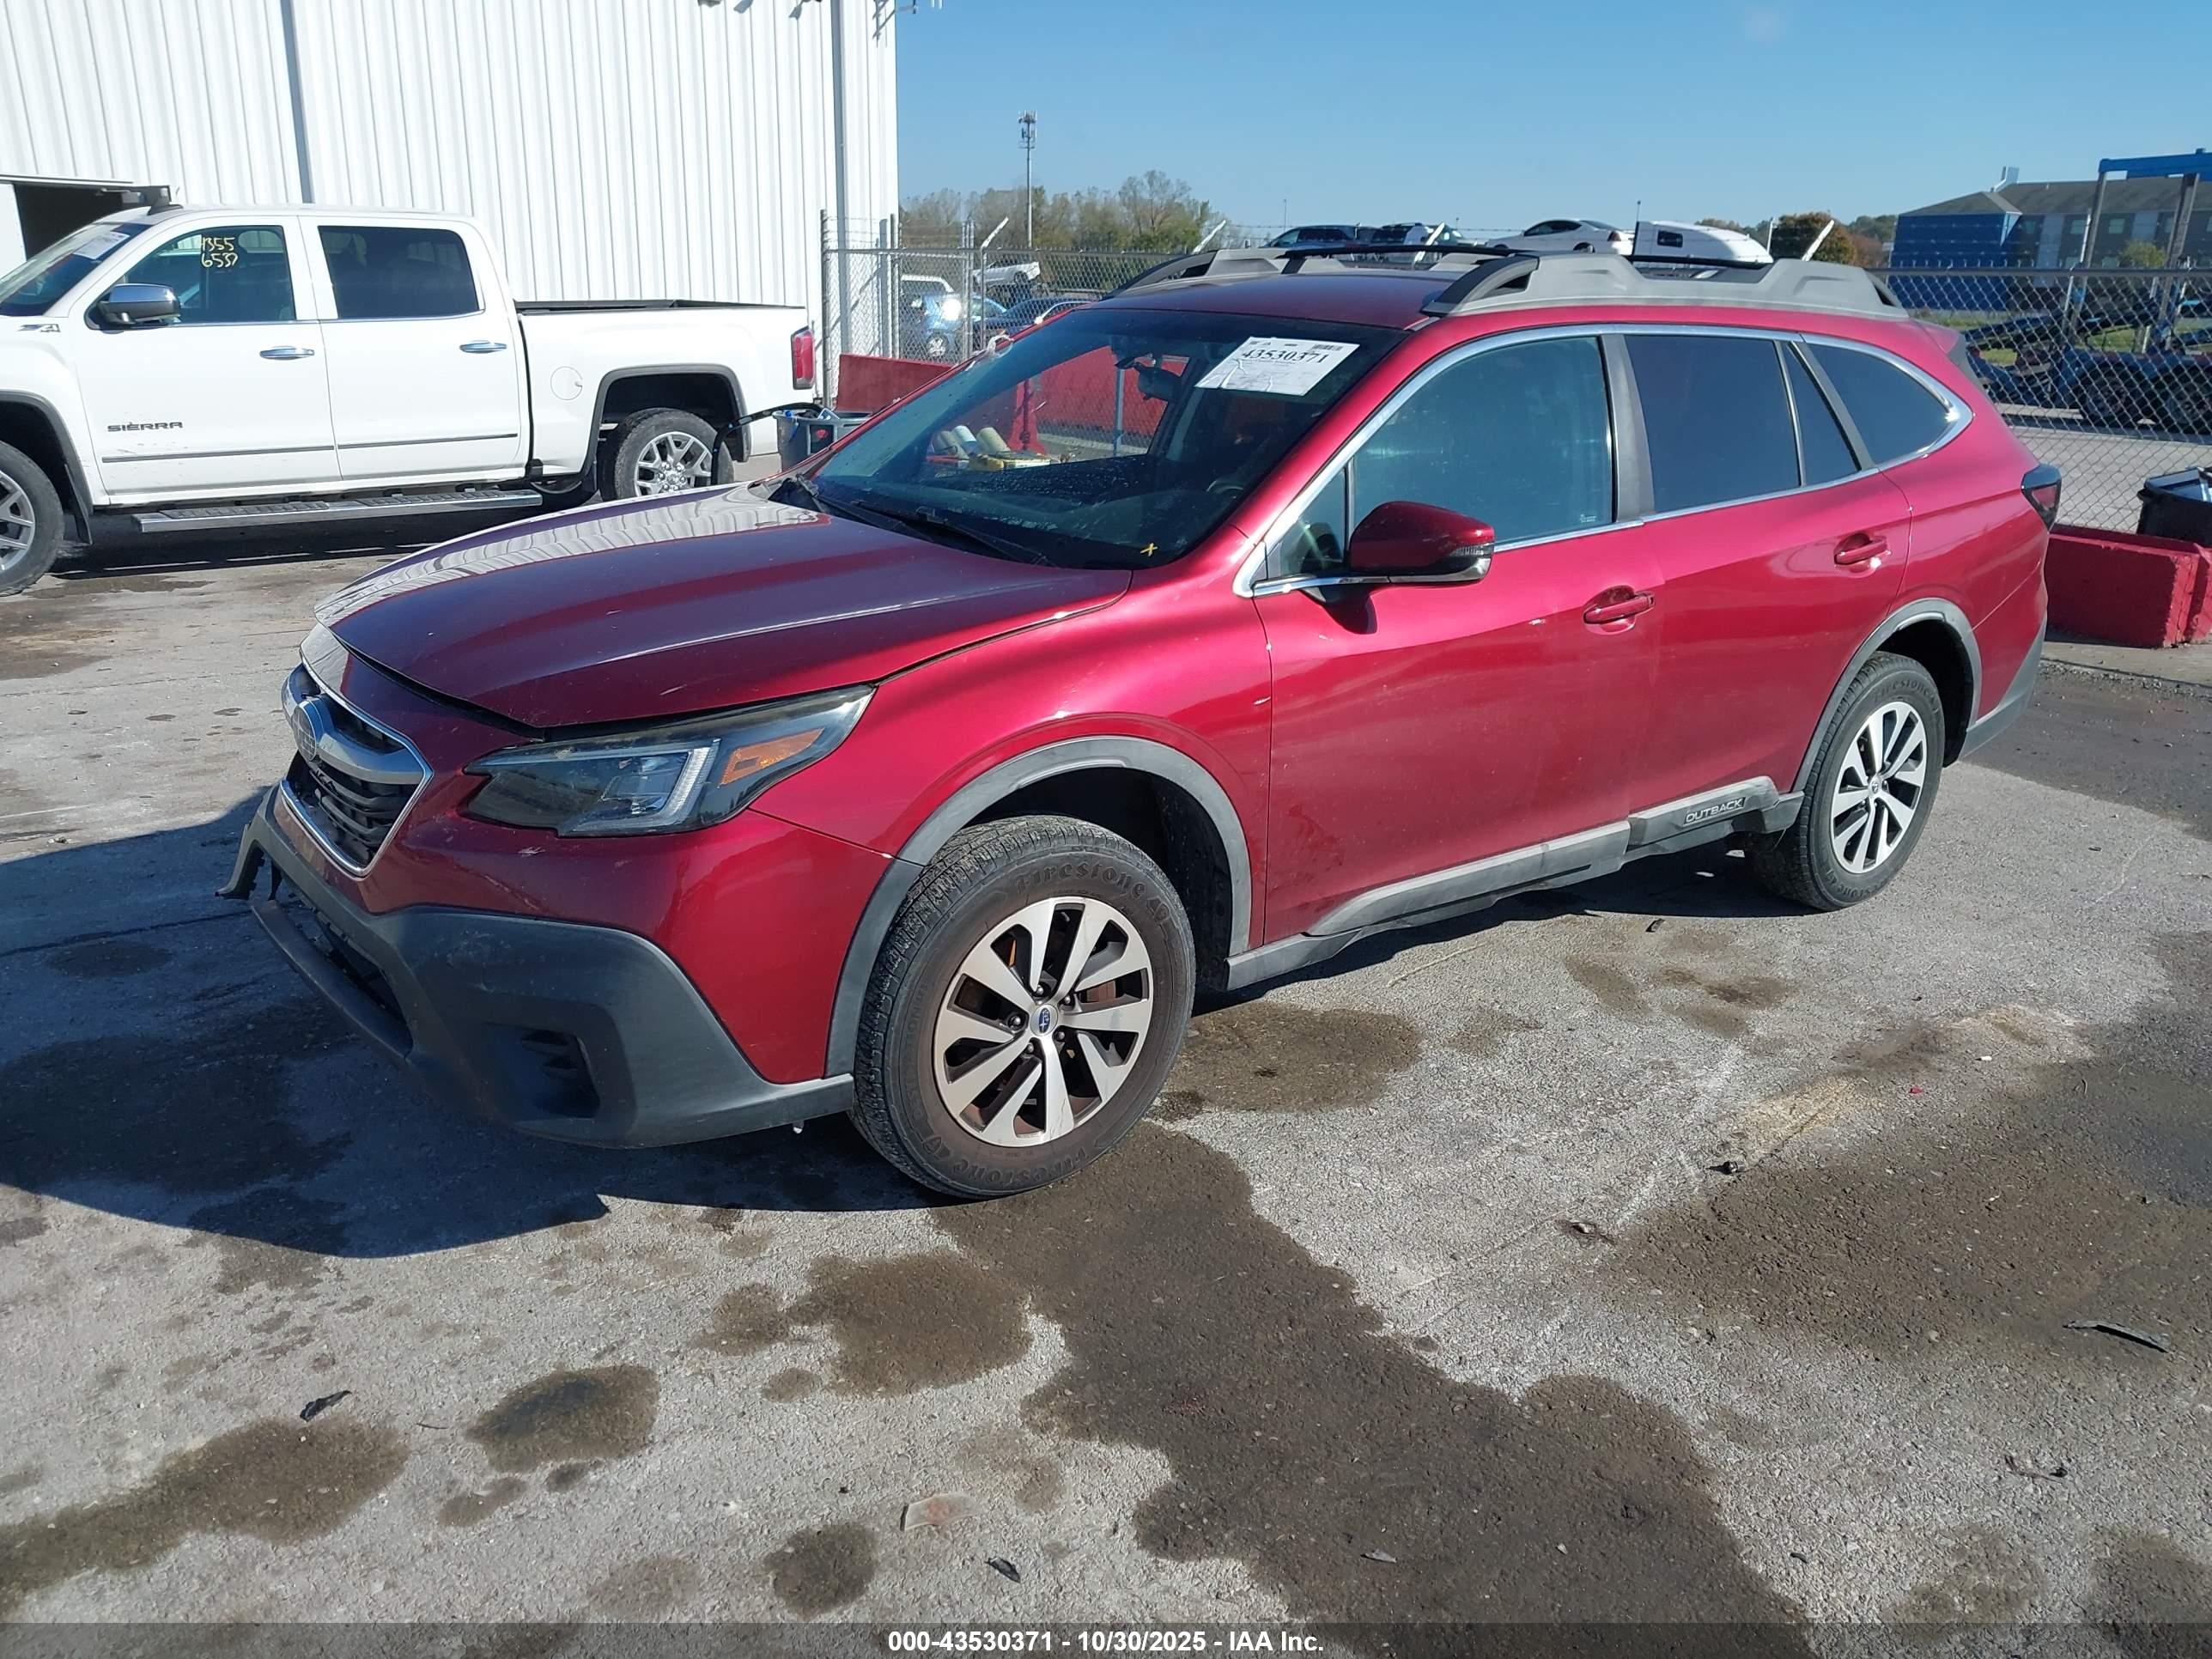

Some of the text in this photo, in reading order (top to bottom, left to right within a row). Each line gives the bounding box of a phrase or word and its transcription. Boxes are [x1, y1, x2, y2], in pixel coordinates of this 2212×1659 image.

[201, 252, 239, 268] 6537
[1242, 349, 1329, 363] 43530371
[107, 422, 183, 432] SIERRA
[1686, 797, 1744, 823] OUTBACK
[1016, 860, 1146, 899] Firestone
